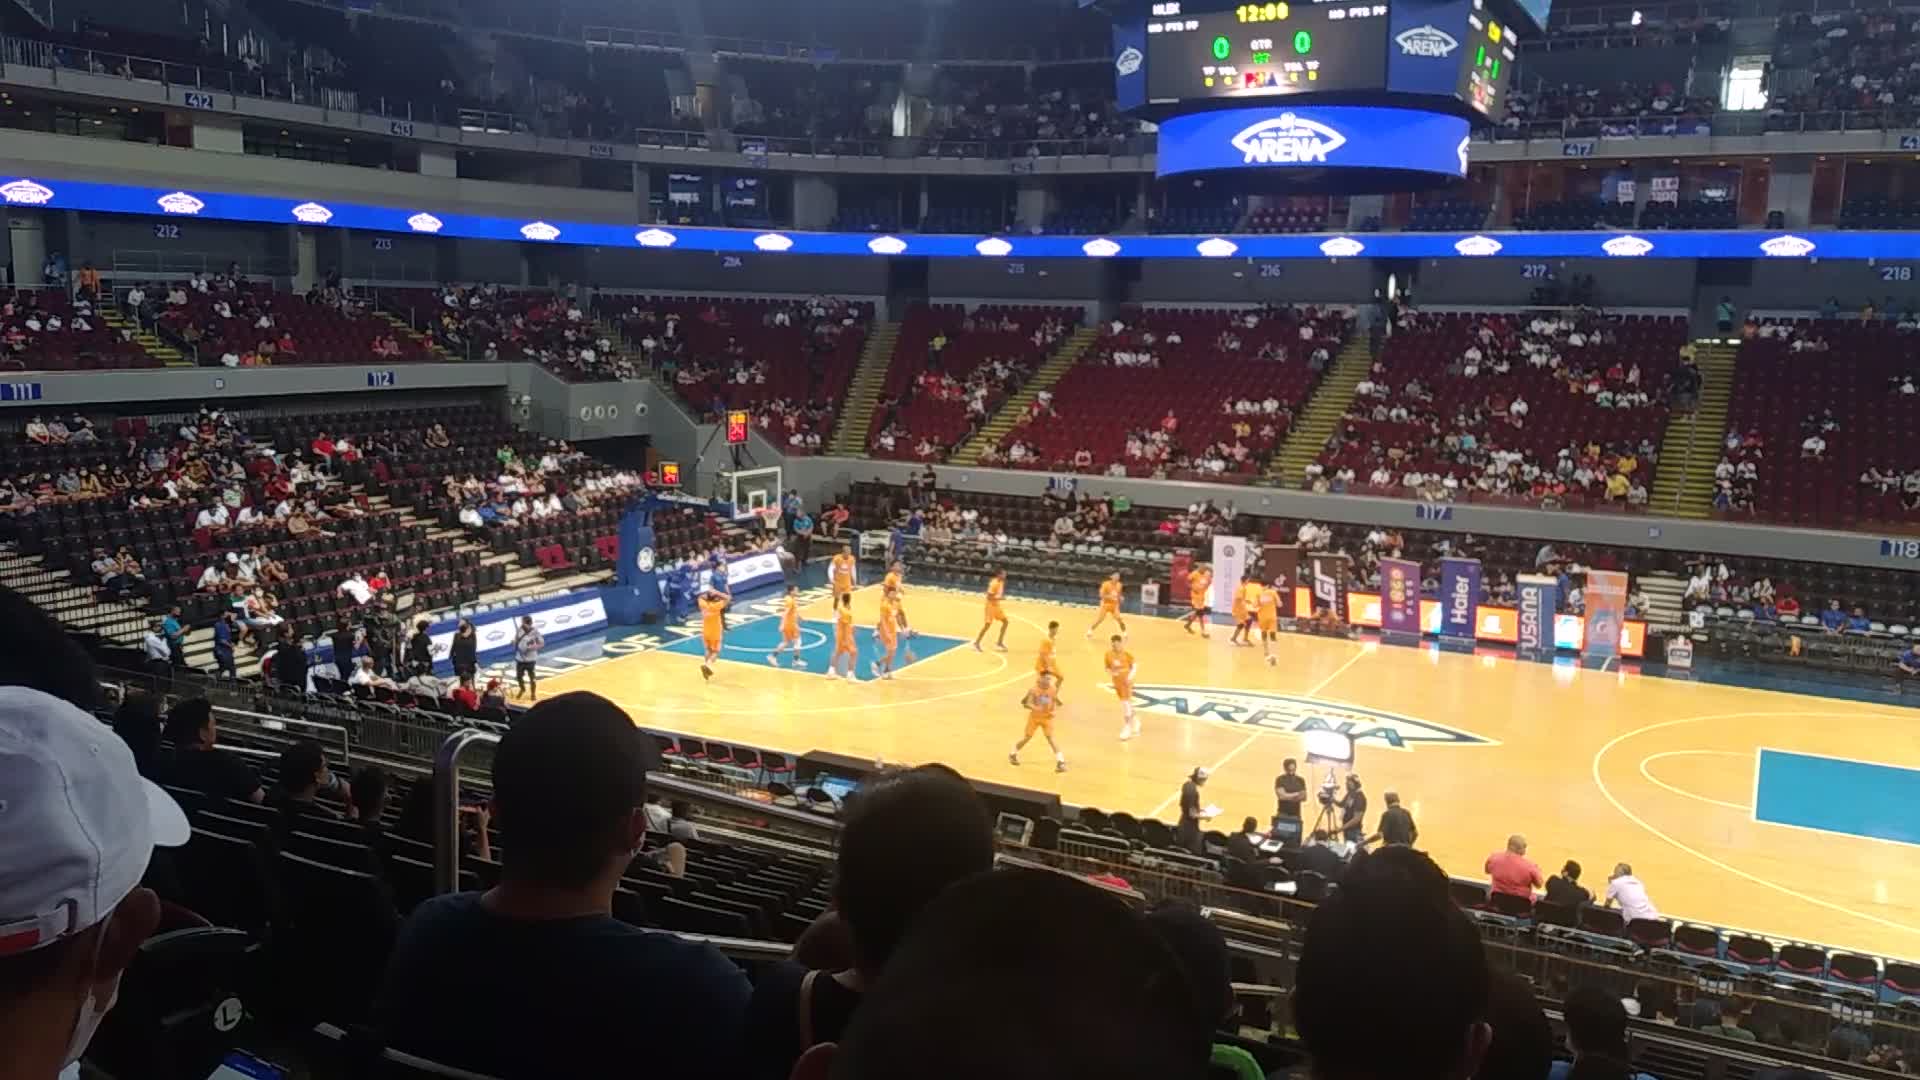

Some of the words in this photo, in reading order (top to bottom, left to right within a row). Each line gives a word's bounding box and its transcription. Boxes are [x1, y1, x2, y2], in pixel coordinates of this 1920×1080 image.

[1236, 2, 1289, 22] 12:00
[1213, 37, 1230, 59] 0
[1294, 31, 1311, 54] 0
[1401, 39, 1448, 58] ARENA
[1243, 137, 1327, 164] ARENA
[156, 224, 179, 238] 212
[1260, 264, 1281, 277] 216
[1522, 263, 1547, 278] 217
[1882, 266, 1912, 281] 218
[372, 371, 391, 387] 112
[10, 383, 33, 400] 111
[1423, 504, 1447, 520] 117
[1889, 540, 1920, 559] 118
[1450, 575, 1470, 625] Haier
[1521, 586, 1538, 649] USANA
[602, 633, 663, 654] OF
[1131, 691, 1406, 749] ARENA
[222, 1005, 237, 1027] L
